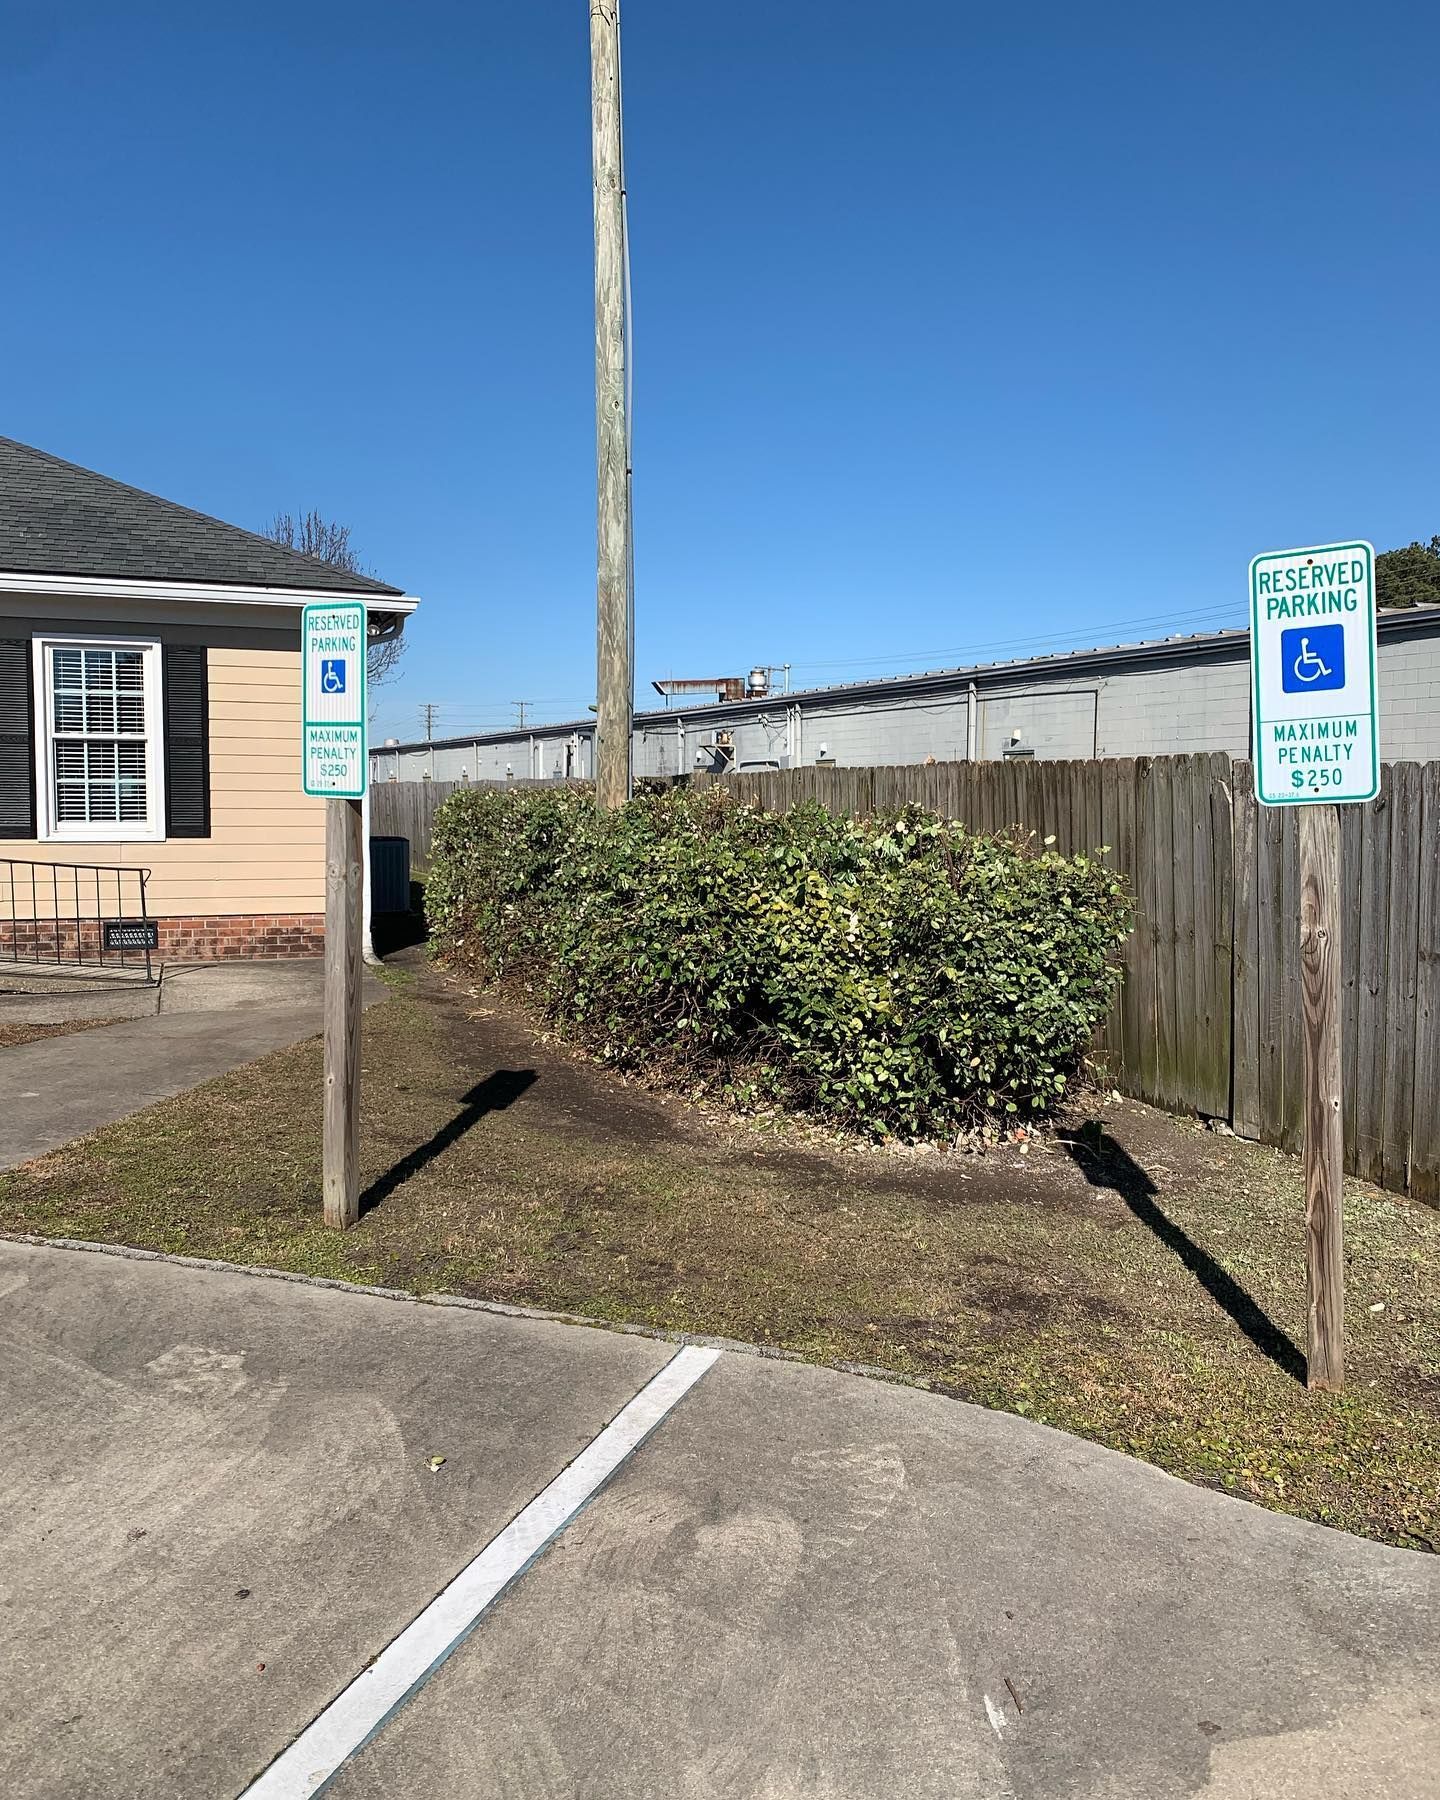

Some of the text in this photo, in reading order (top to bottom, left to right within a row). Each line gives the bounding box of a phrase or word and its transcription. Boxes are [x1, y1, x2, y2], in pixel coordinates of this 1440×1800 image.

[1259, 560, 1364, 594] RESERVED
[1267, 588, 1357, 620] PARKING
[308, 614, 359, 631] RESERVED
[312, 637, 356, 653] PARKING
[310, 730, 357, 743] MAXIMUM
[1274, 720, 1357, 742] MAXIMUM
[311, 747, 356, 760] PENALTY
[1279, 743, 1353, 764] PENALTY
[320, 764, 347, 776] $250
[1291, 768, 1342, 788] $250
